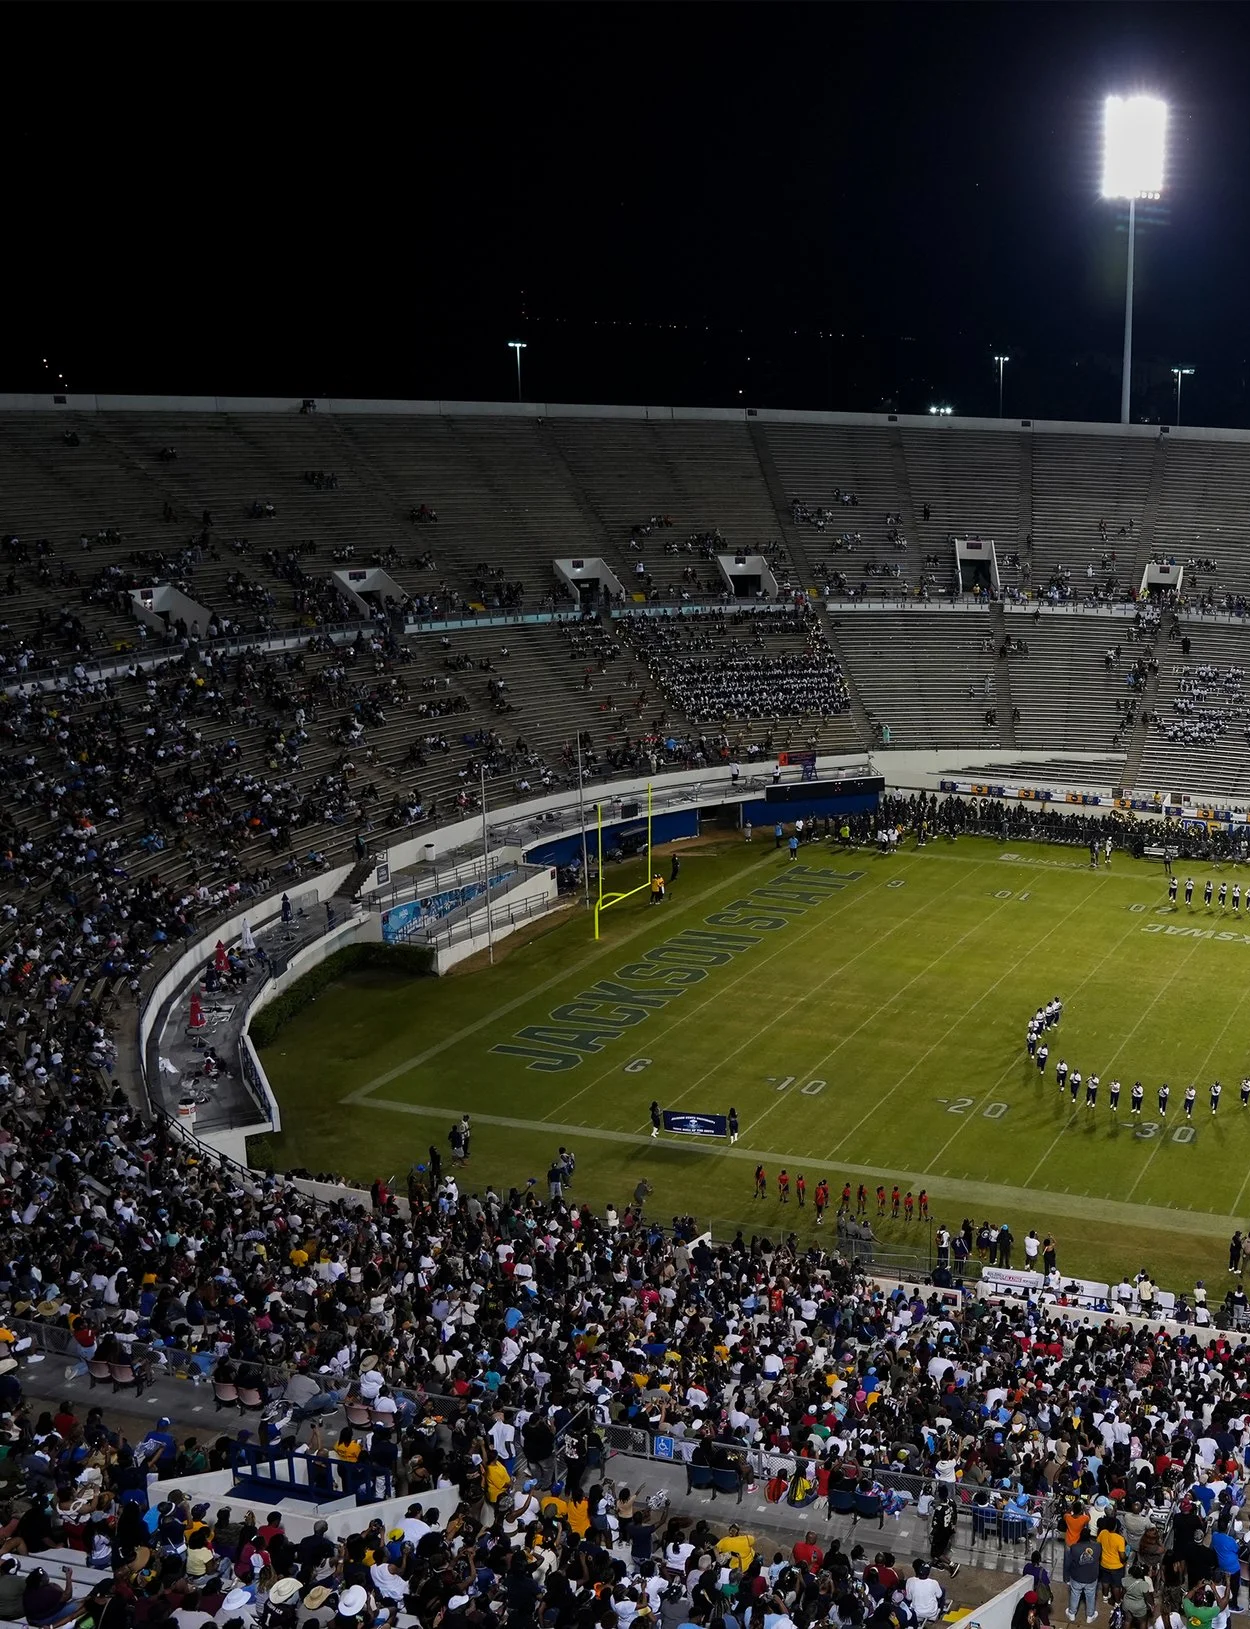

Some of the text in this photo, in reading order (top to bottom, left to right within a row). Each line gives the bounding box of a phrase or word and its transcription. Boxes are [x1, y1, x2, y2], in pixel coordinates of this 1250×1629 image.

[1140, 923, 1239, 941] SWAC
[488, 864, 869, 1072] JACKSON STATE
[623, 1058, 653, 1072] G
[776, 1075, 827, 1096] 10
[946, 1098, 1008, 1119] 20
[1135, 1121, 1197, 1144] 30
